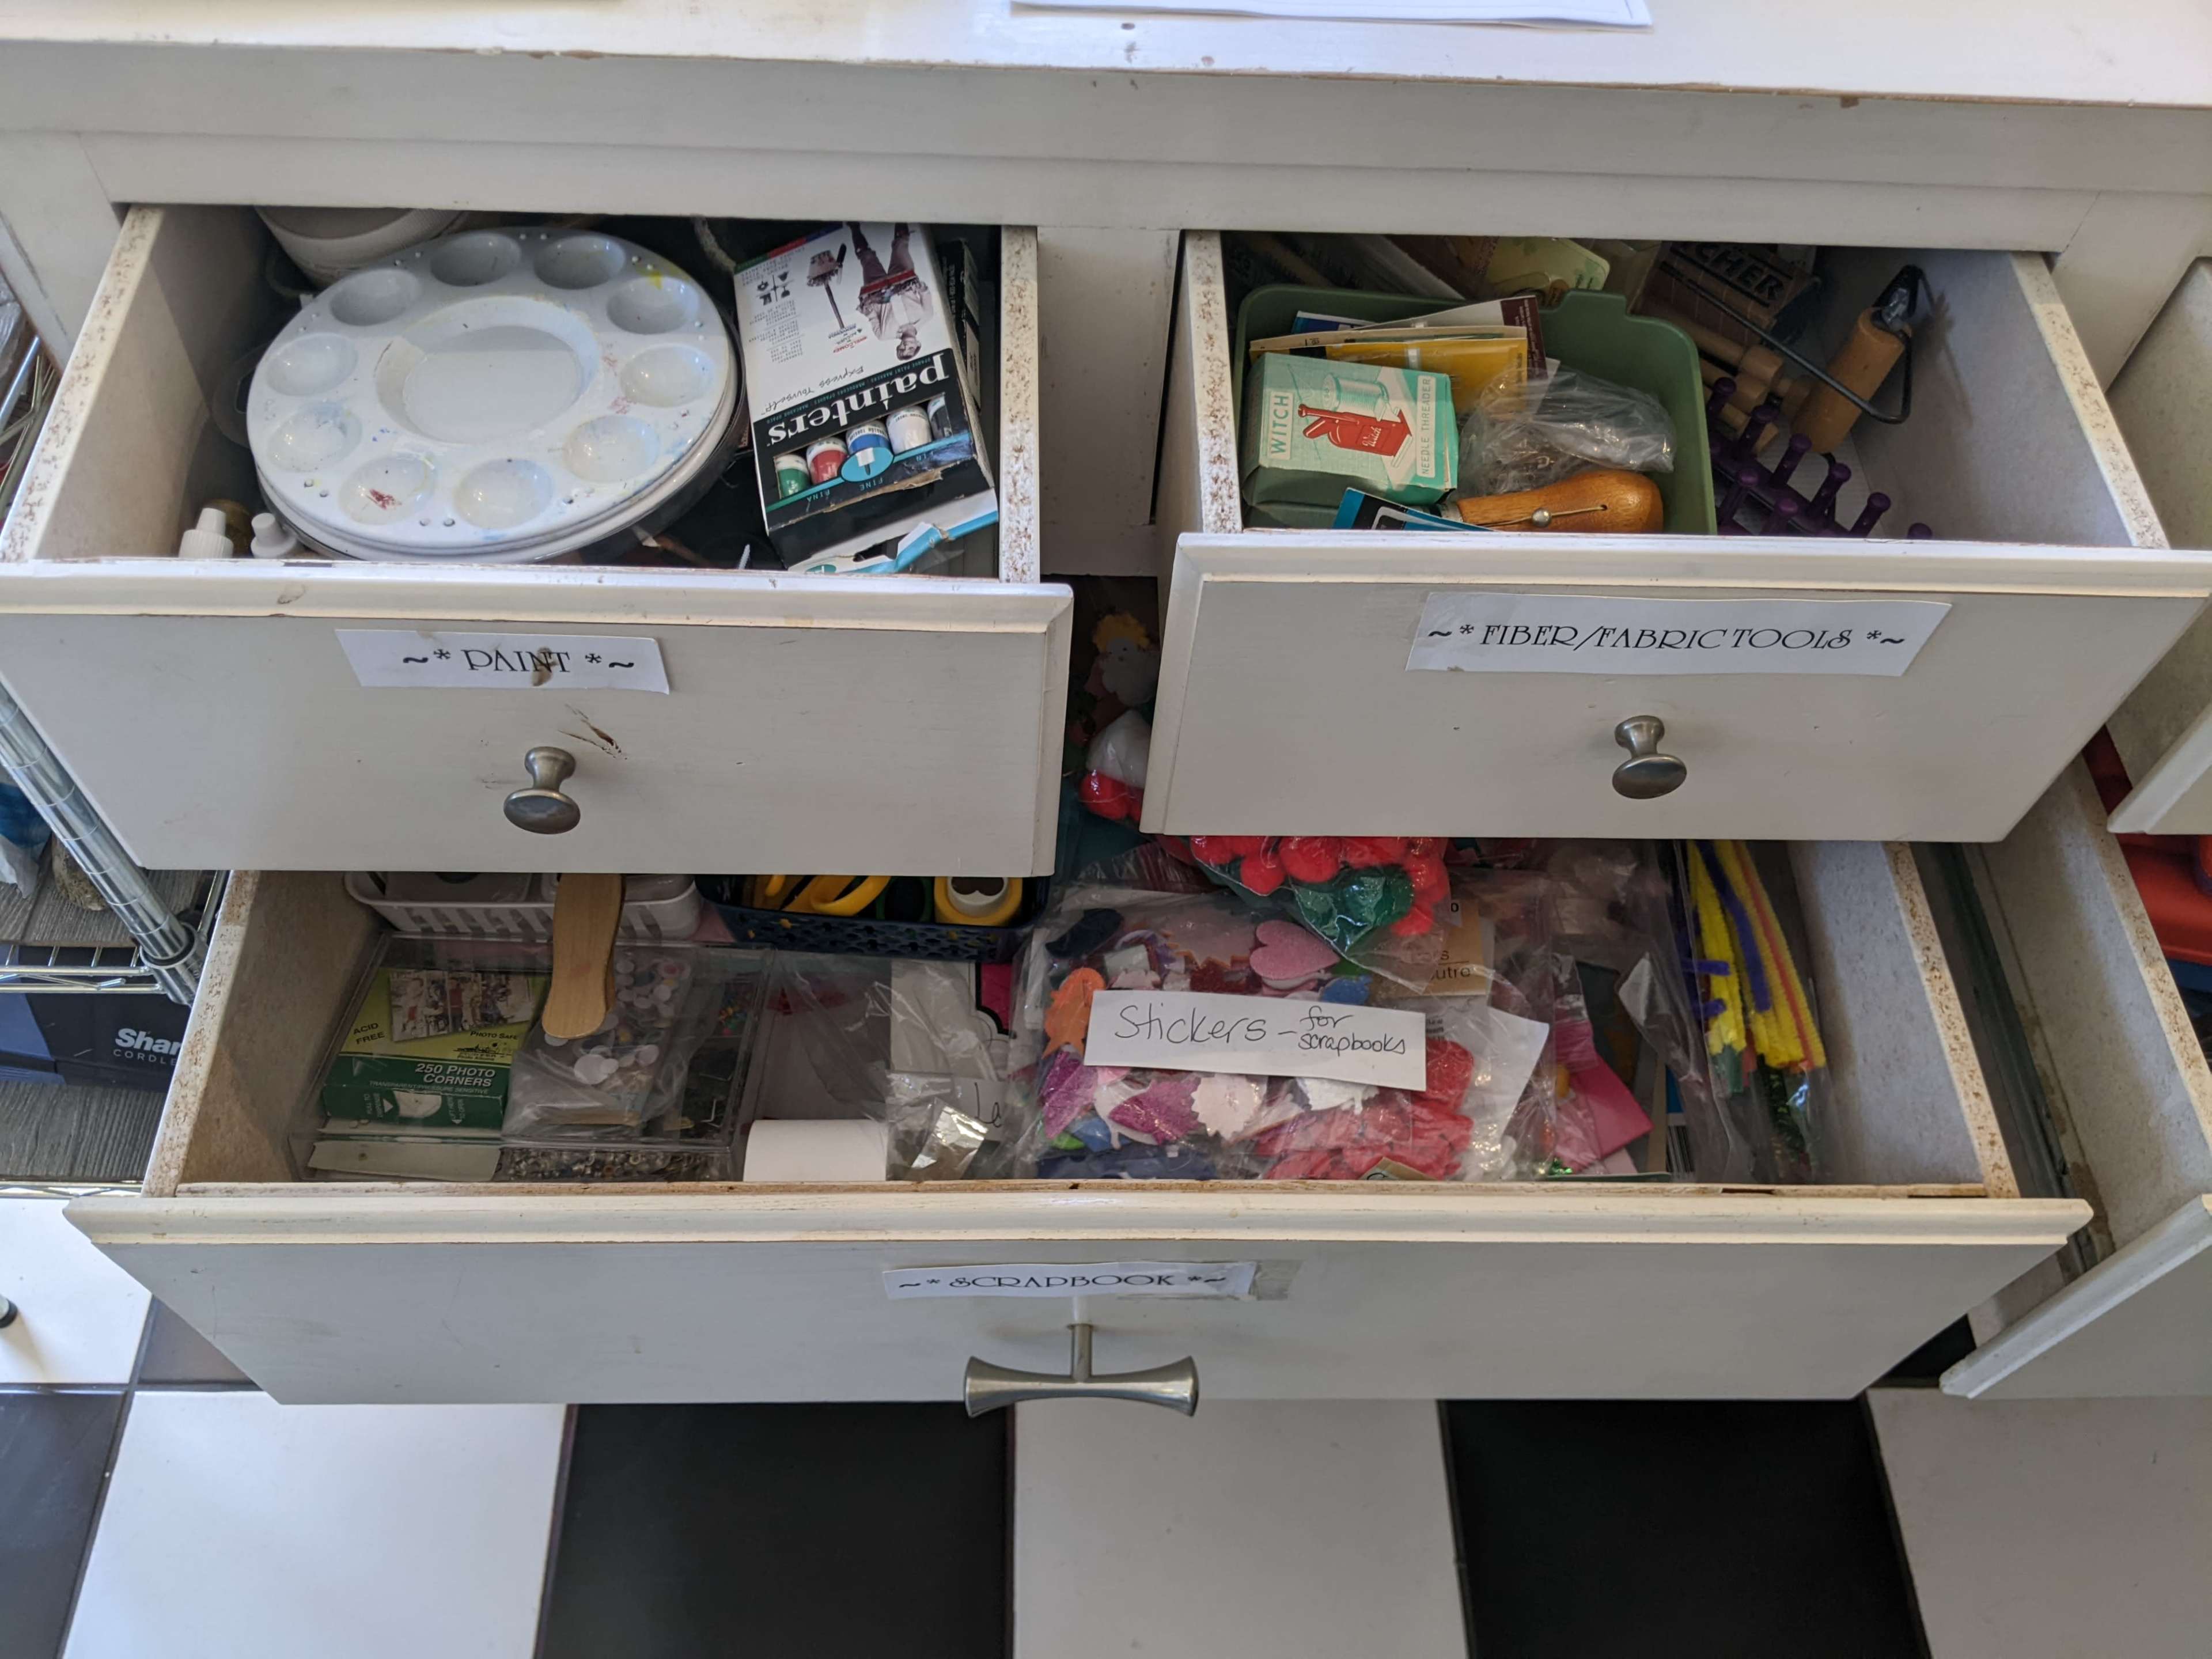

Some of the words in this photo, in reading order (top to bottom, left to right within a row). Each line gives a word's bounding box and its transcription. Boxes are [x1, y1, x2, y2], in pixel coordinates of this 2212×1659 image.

[768, 352, 949, 446] painters
[1421, 378, 1431, 432] THREADER
[1271, 395, 1290, 454] WITCH
[1362, 425, 1381, 448] Witch
[1421, 437, 1430, 475] NEEDLE
[859, 478, 883, 490] FINE
[461, 649, 572, 673] PAINT
[1429, 967, 1471, 980] utre
[1115, 1002, 1267, 1044] Stickers
[1299, 1005, 1355, 1028] for
[353, 1022, 379, 1035] ACID
[355, 1032, 385, 1044] FREE
[1297, 1032, 1406, 1056] scrapbooks
[415, 1063, 443, 1074] 250
[949, 1274, 1175, 1289] SCRAPBOOK
